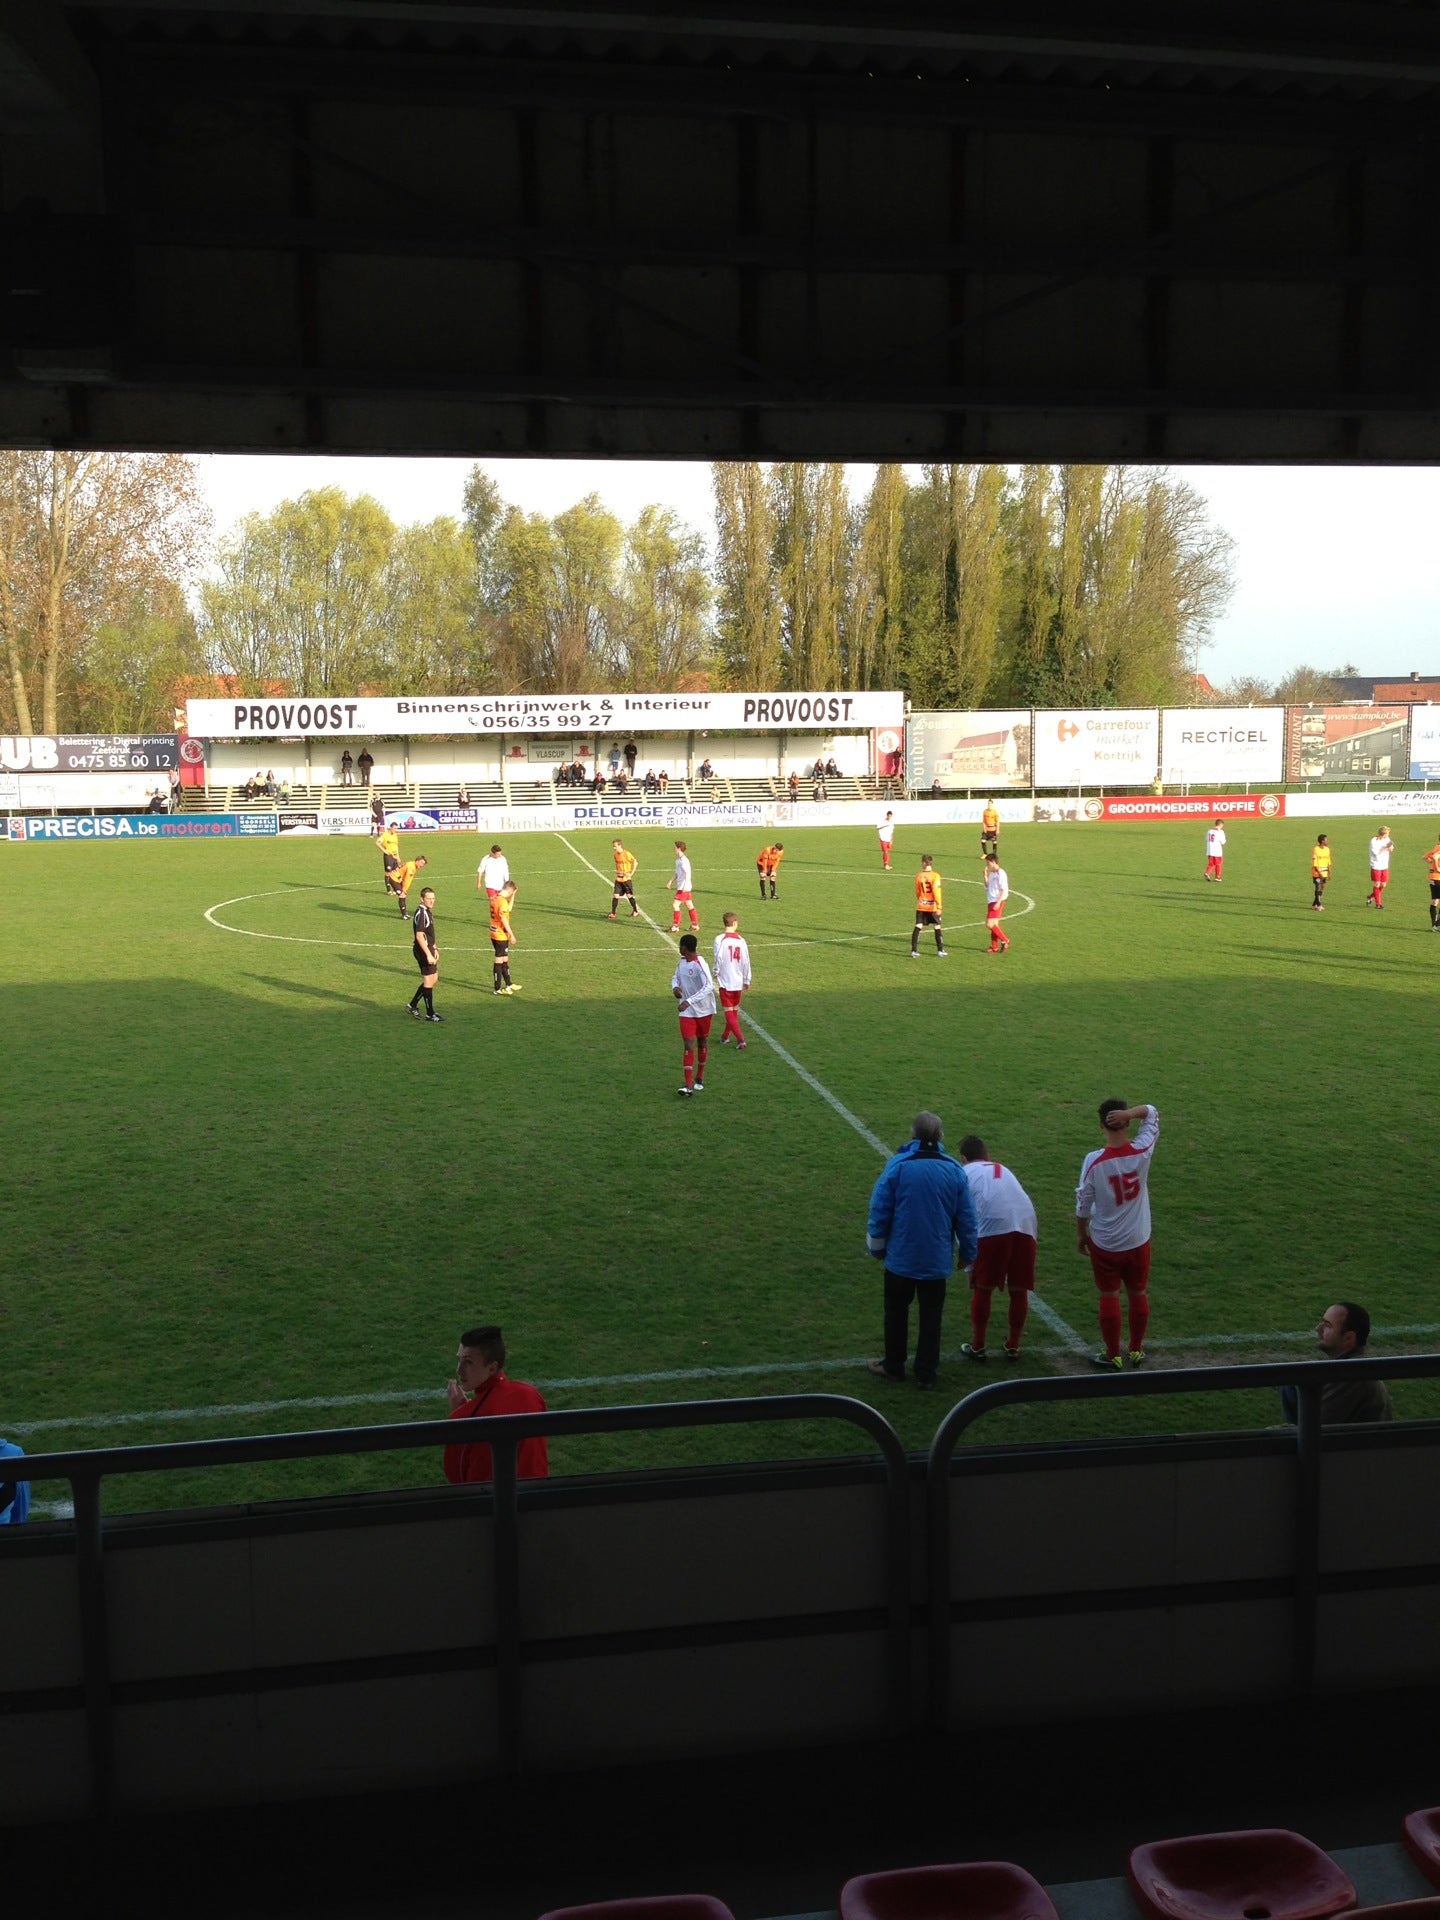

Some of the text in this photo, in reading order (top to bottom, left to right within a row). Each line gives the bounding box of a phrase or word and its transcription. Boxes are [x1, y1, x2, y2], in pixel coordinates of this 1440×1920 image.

[397, 698, 711, 715] Binnenschrijnwerk & Interieur
[744, 698, 853, 722] PROVOOST
[234, 704, 357, 730] PROVOOST
[482, 714, 612, 728] 056/35 99 27
[1327, 711, 1400, 721] www.stampkot.be
[1086, 719, 1151, 730] Carrefour
[59, 737, 106, 747] Belettering
[113, 737, 140, 748] Digital
[143, 736, 175, 747] printing
[1291, 713, 1301, 777] RESTAURANT
[0, 736, 59, 770] UB
[92, 746, 131, 754] Zeefdruk
[535, 750, 565, 759] VLASCUP
[1094, 751, 1142, 762] Kortrijk
[69, 754, 171, 768] 0475 85 00 12
[574, 807, 662, 818] DELORGE
[667, 804, 762, 815] ZONNEPANELEN
[1108, 801, 1255, 814] GROOTMOEDERS KOFFIE
[29, 817, 232, 838] PRECISA.be motoren
[321, 817, 371, 825] VERSTRAET
[920, 881, 933, 893] 13
[728, 945, 741, 963] 14
[1108, 1170, 1141, 1208] 15
